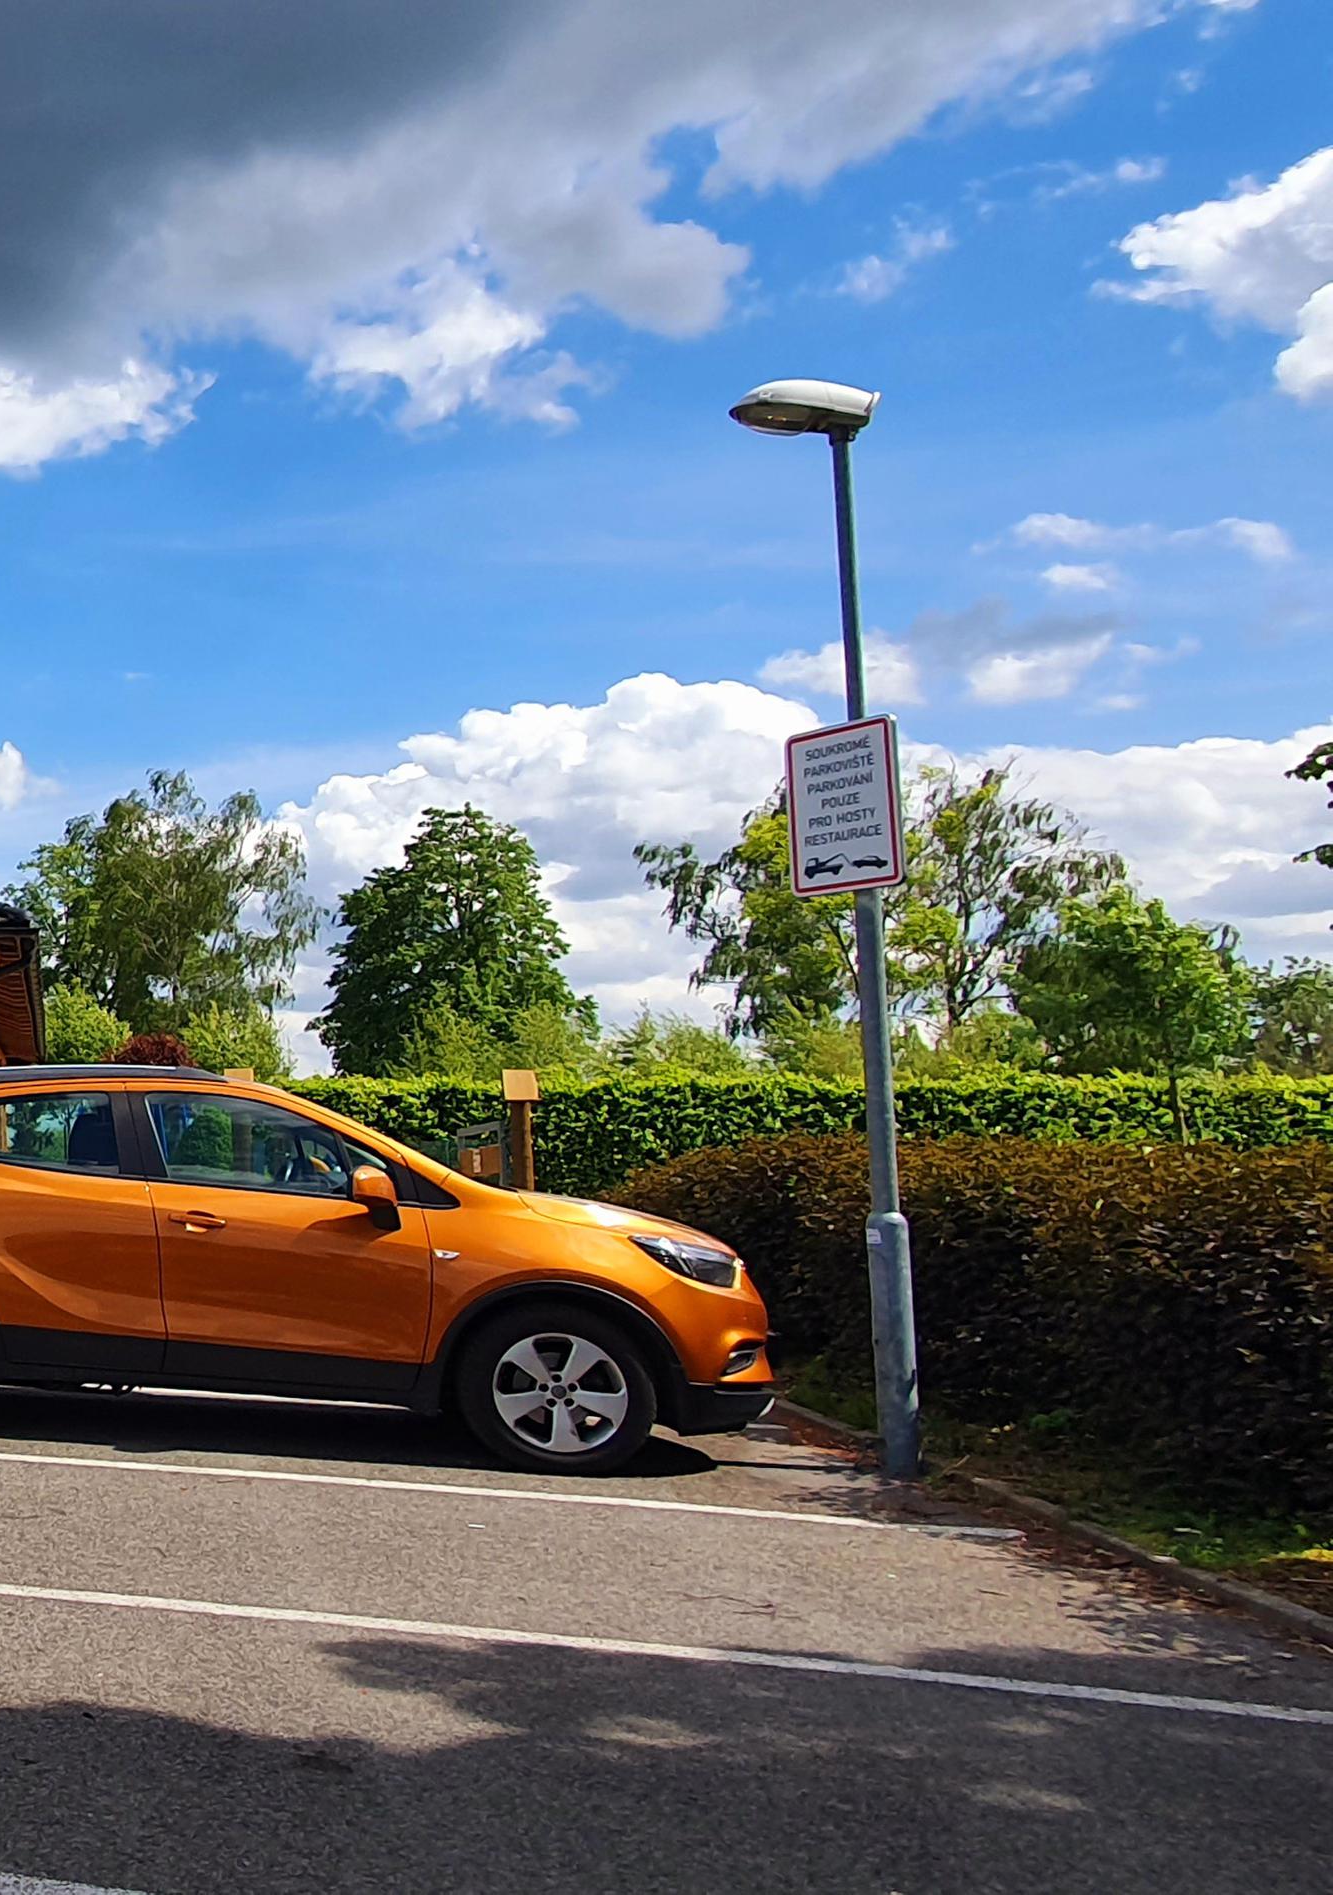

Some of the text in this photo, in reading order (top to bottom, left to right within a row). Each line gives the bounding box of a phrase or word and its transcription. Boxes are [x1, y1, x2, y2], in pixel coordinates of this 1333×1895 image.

[805, 734, 871, 761] SOUKROMÉ
[821, 792, 860, 809] POUZE
[808, 807, 876, 829] PRO HOSTY
[805, 824, 882, 847] RESTAURACE
